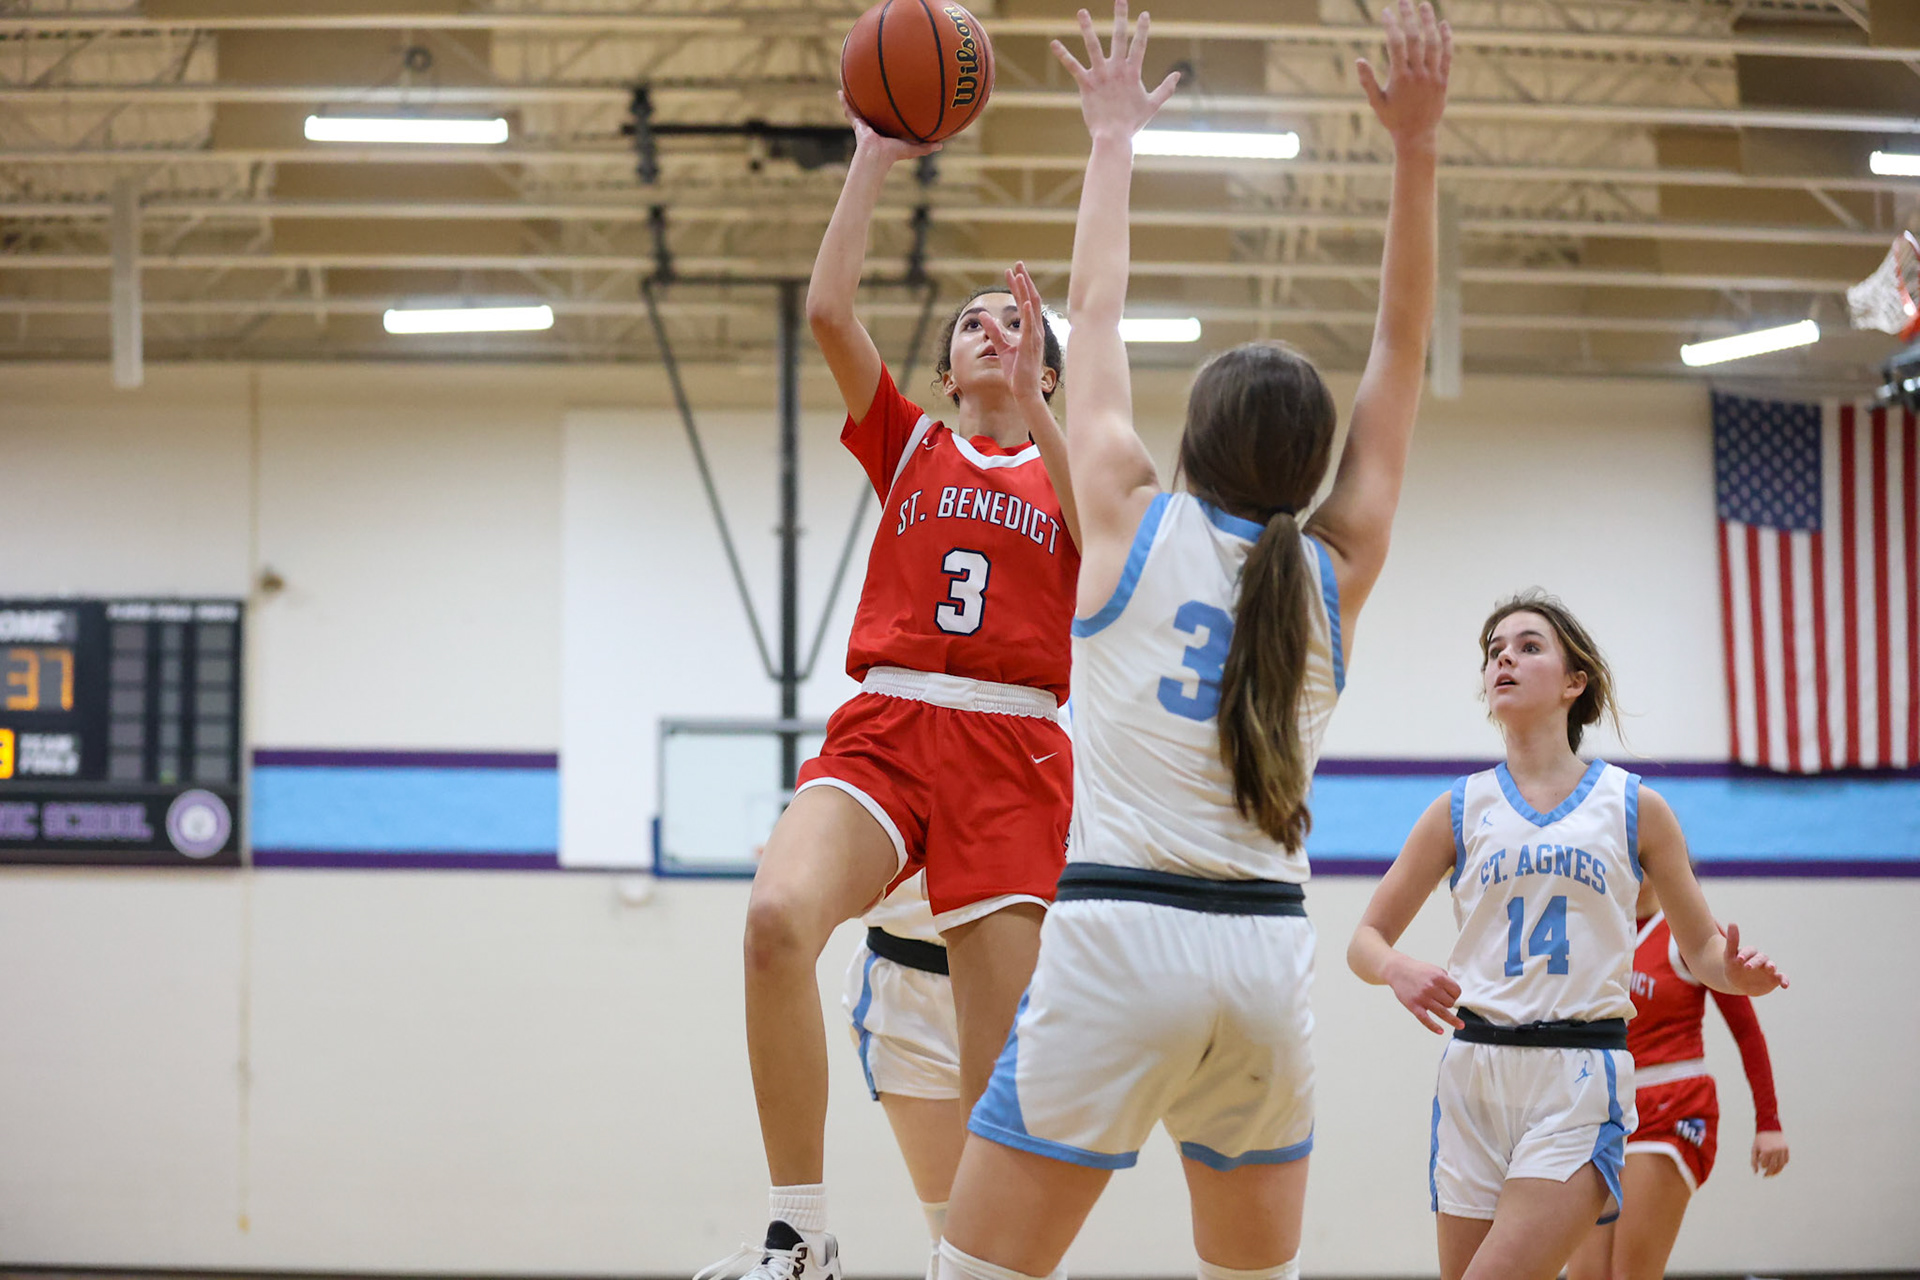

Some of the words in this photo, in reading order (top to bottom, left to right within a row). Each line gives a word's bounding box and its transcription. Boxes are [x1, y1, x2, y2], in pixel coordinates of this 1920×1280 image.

[944, 6, 979, 108] Wilson
[896, 489, 927, 536] ST.
[937, 486, 1061, 555] BENEDICT
[934, 547, 991, 636] 3
[1157, 600, 1235, 722] 3
[1515, 844, 1606, 895] AGNES
[1504, 895, 1570, 977] 14
